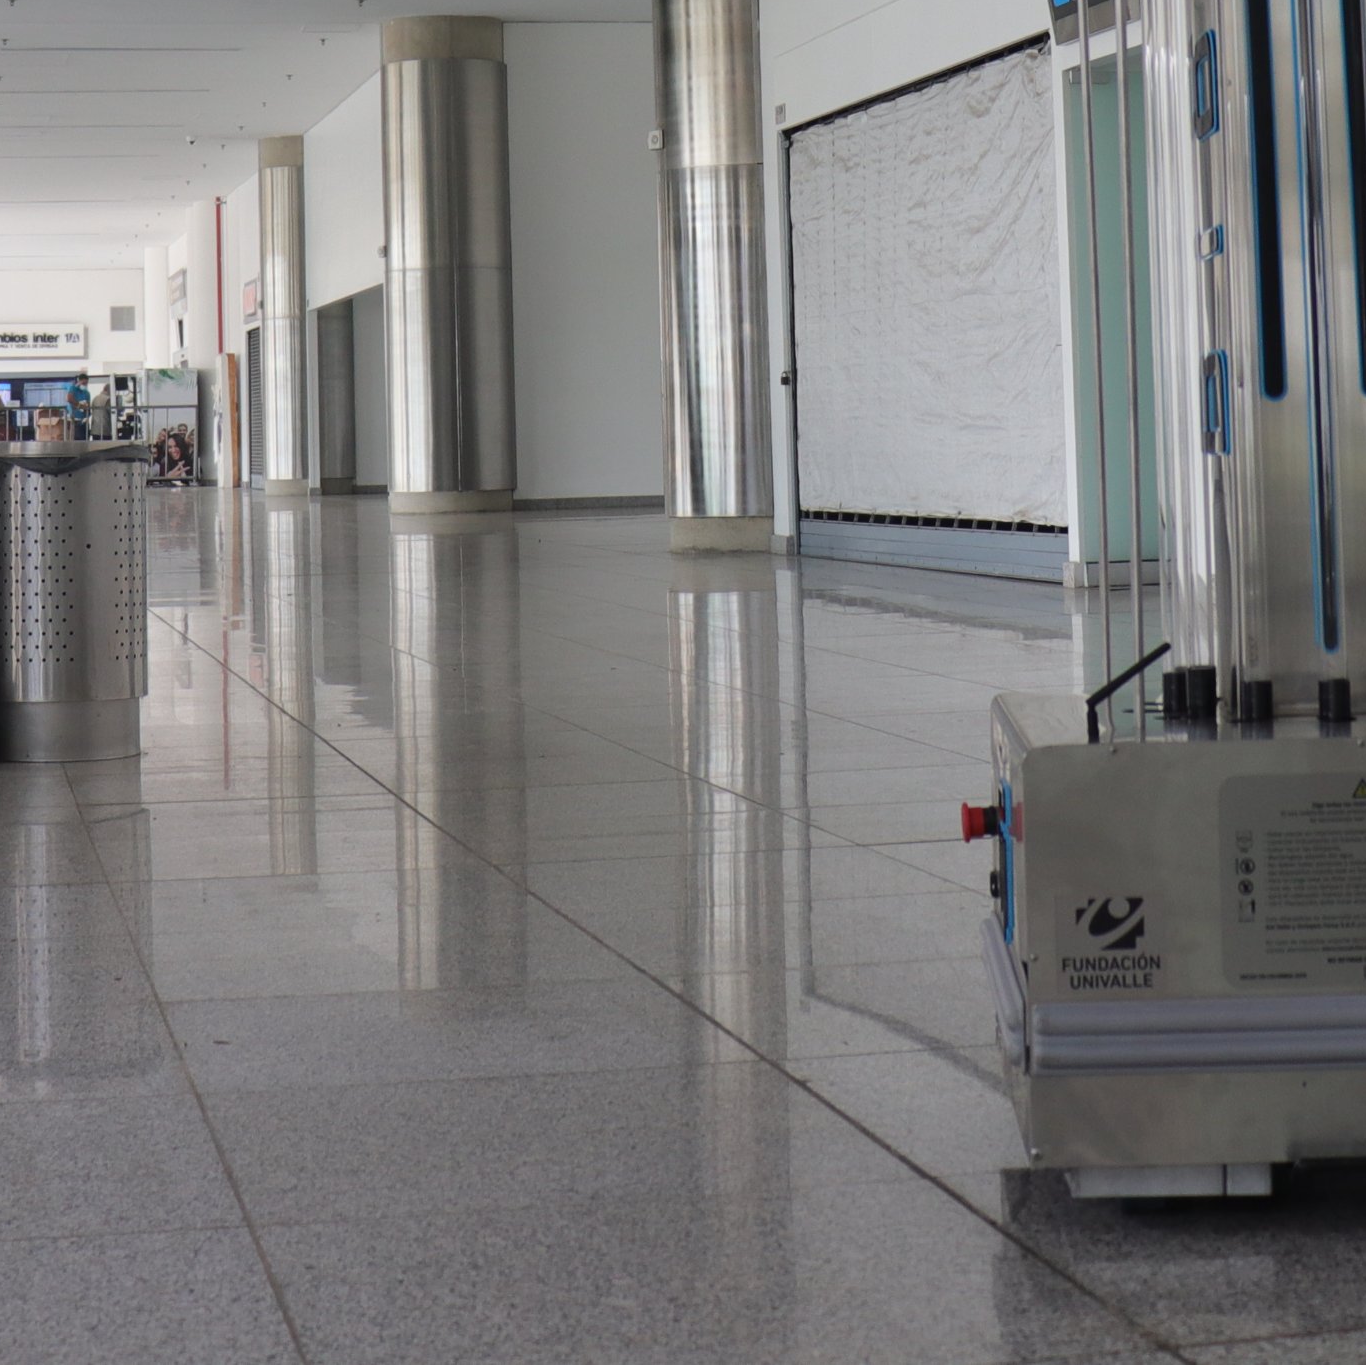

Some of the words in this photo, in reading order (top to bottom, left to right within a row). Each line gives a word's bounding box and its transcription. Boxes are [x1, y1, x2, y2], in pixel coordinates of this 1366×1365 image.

[33, 332, 60, 344] inter
[1061, 950, 1161, 973] FUNDACIÓN
[1069, 972, 1154, 990] UNIVALLE
